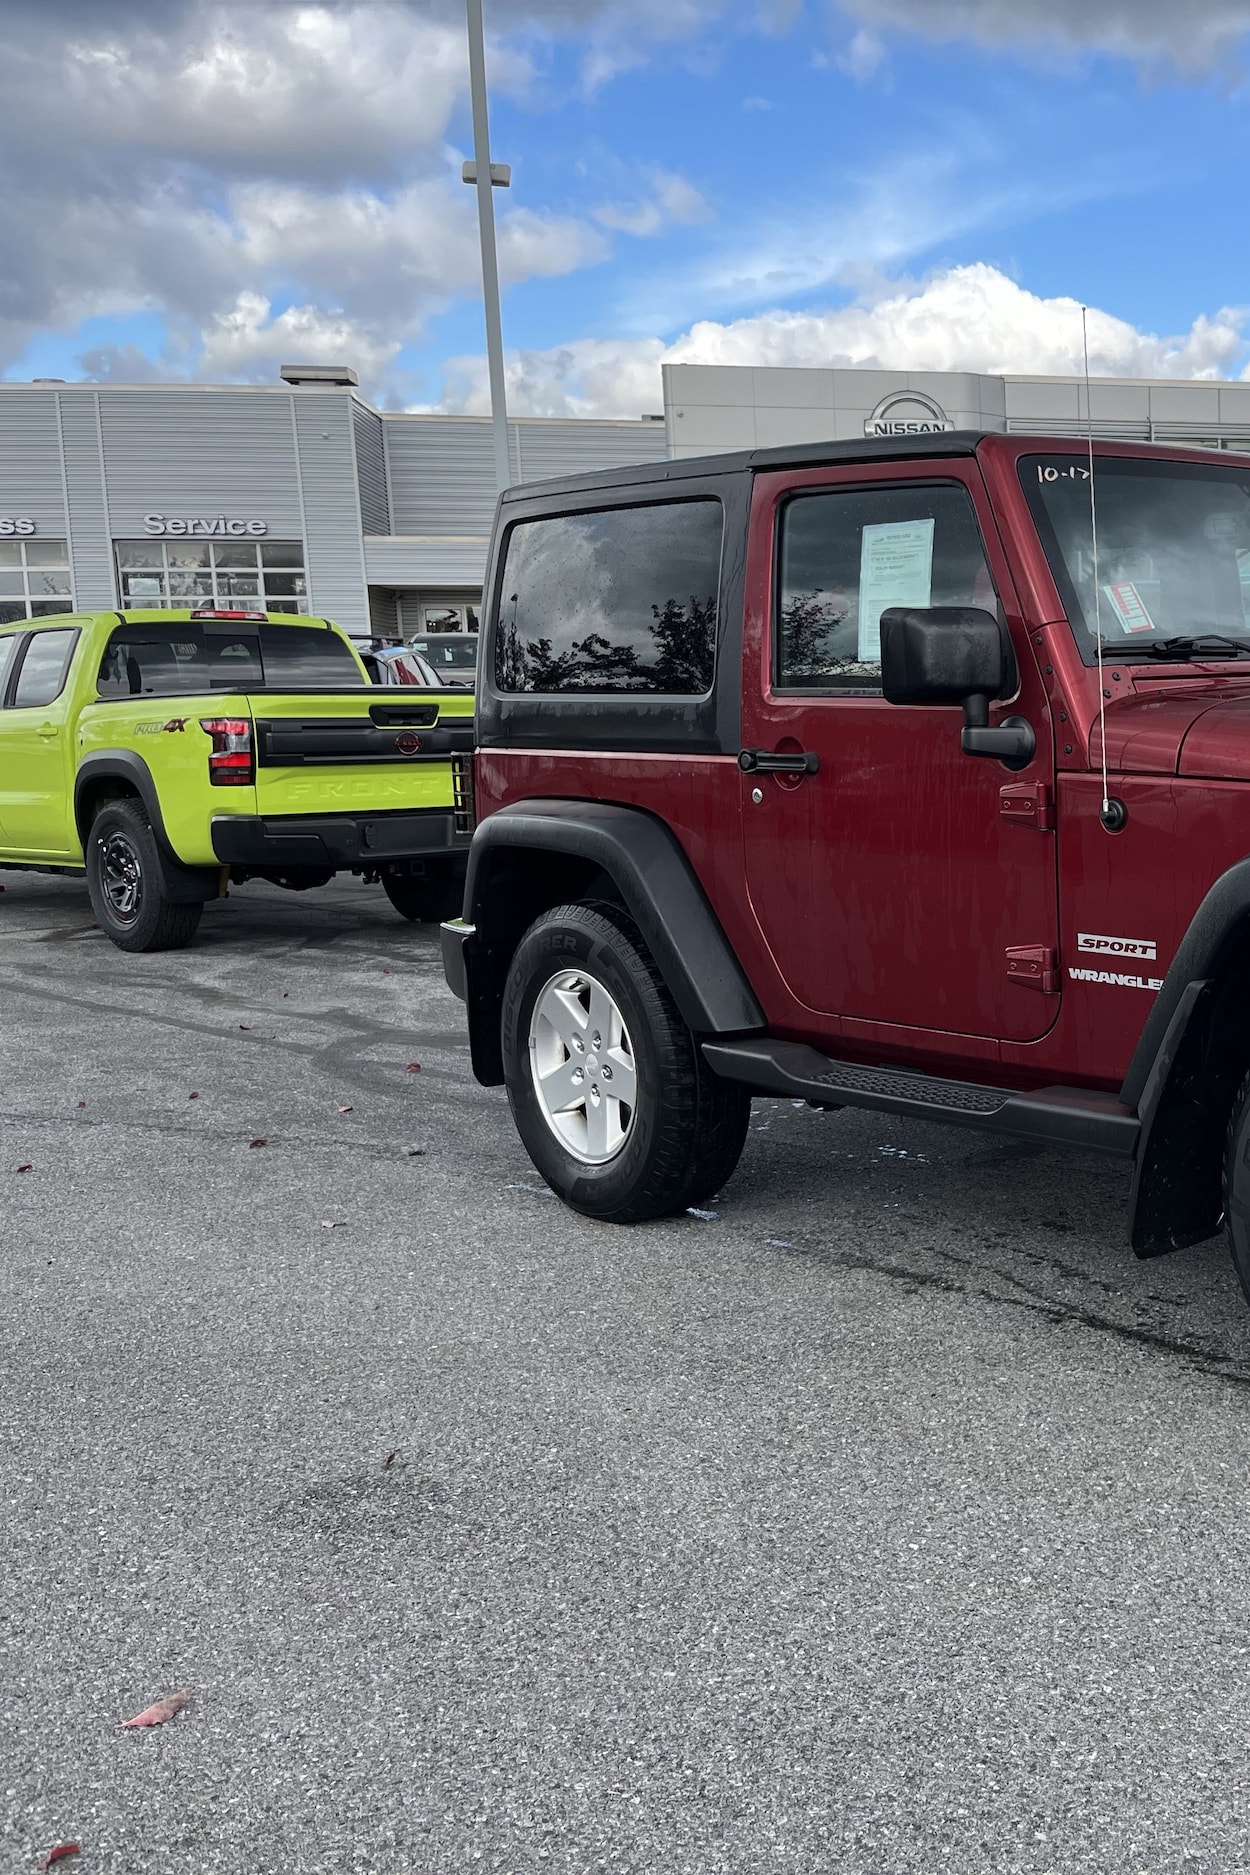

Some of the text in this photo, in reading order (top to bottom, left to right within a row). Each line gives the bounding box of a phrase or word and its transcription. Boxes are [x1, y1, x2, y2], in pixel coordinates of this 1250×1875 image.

[874, 423, 945, 436] NISSAN
[143, 513, 268, 536] Service
[286, 777, 453, 800] FRONT
[1082, 938, 1150, 955] SPORT
